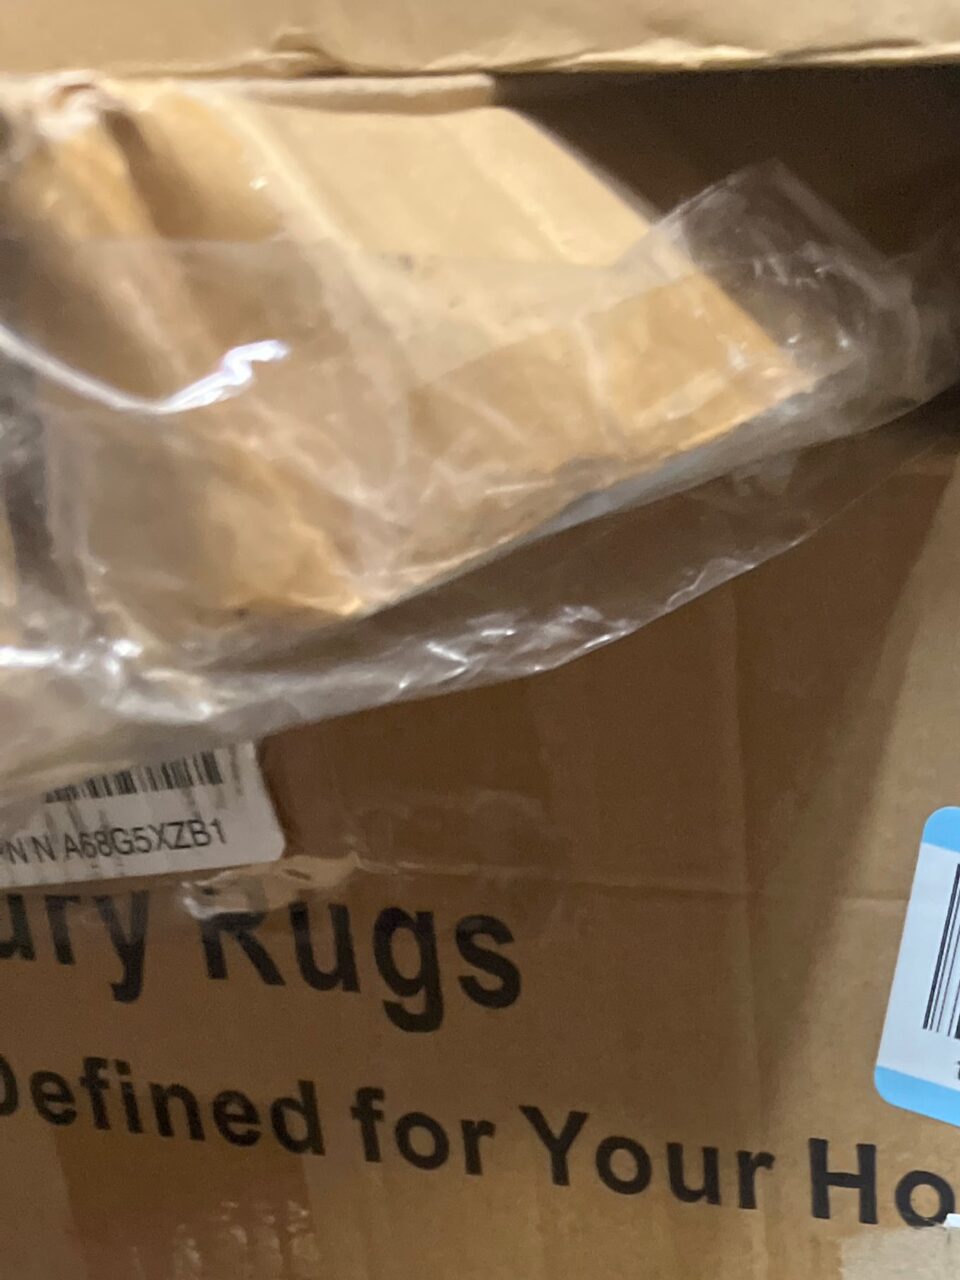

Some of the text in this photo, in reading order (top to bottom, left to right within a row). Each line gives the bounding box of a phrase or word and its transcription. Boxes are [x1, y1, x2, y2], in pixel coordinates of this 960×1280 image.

[200, 898, 521, 1033] Rugs
[351, 1086, 495, 1175] for
[518, 1104, 775, 1209] Your
